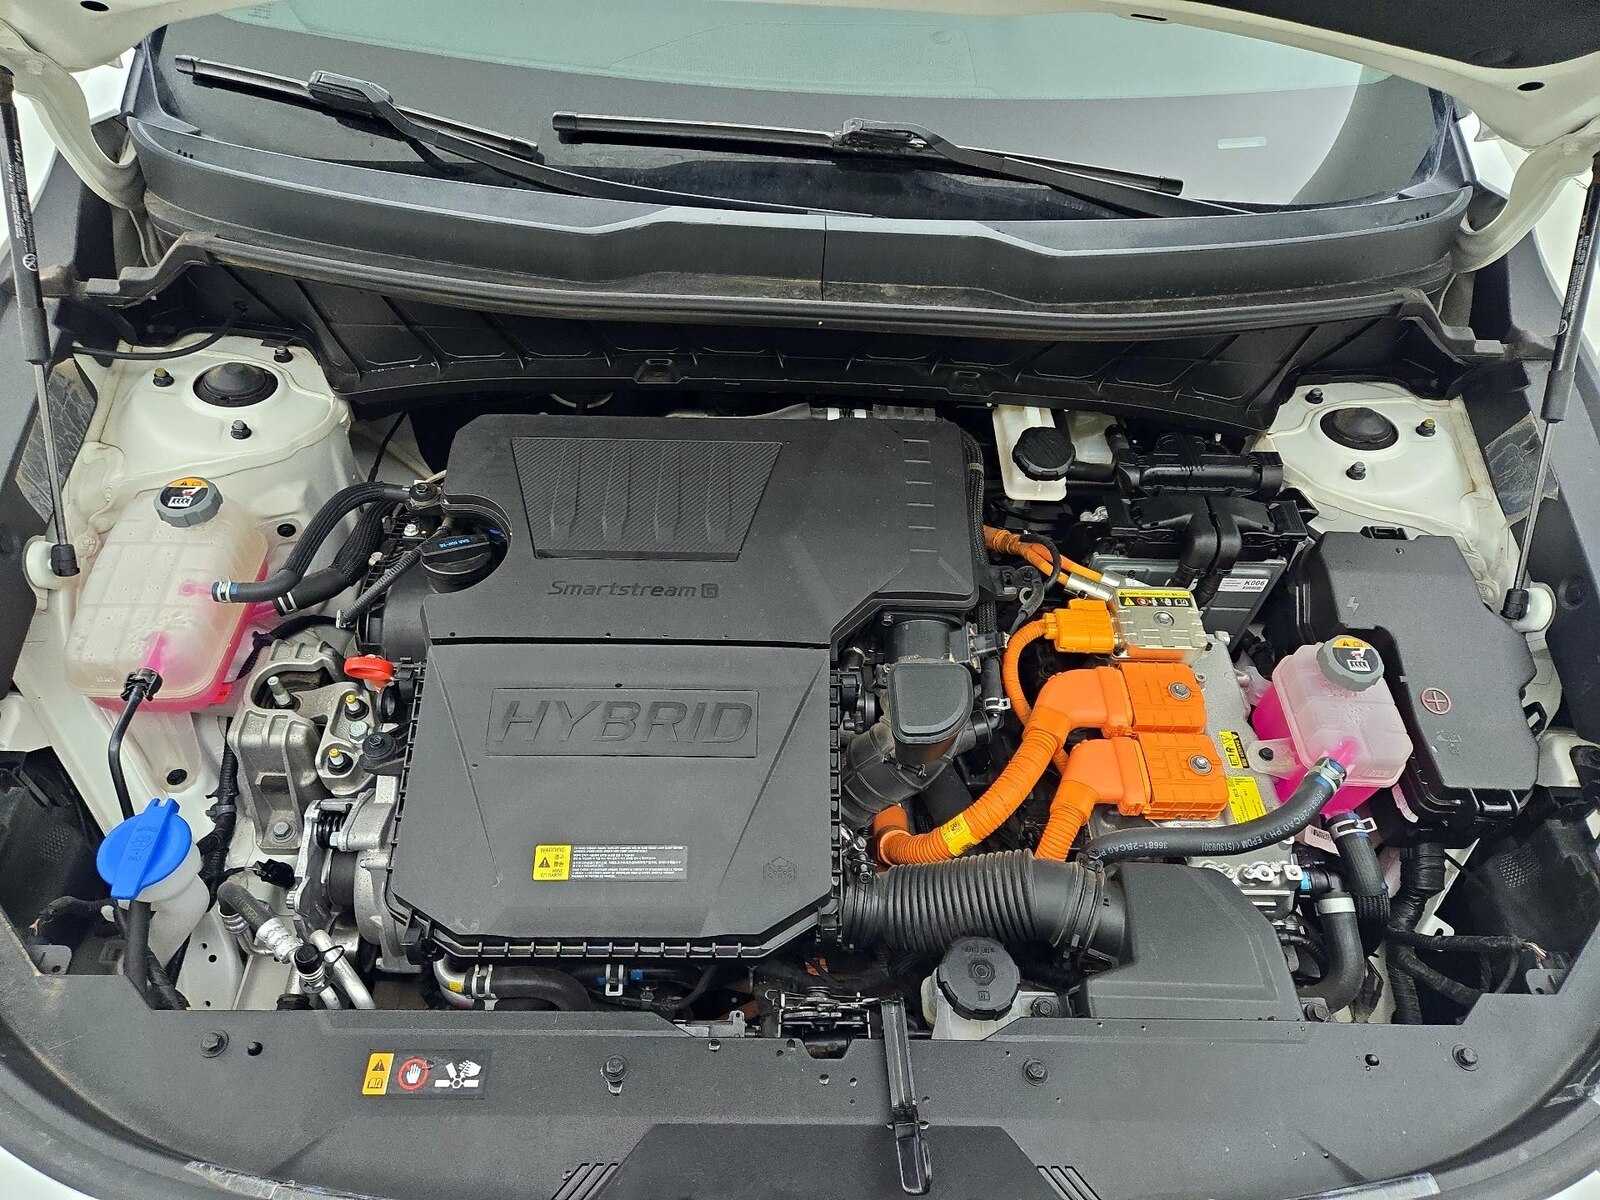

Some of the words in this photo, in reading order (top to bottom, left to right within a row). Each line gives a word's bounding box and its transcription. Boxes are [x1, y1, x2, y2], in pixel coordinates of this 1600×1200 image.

[548, 580, 697, 597] Smartstream
[495, 700, 753, 743] HYBRID
[1108, 841, 1168, 854] 36681-2BCA0
[1241, 836, 1263, 849] EPDM
